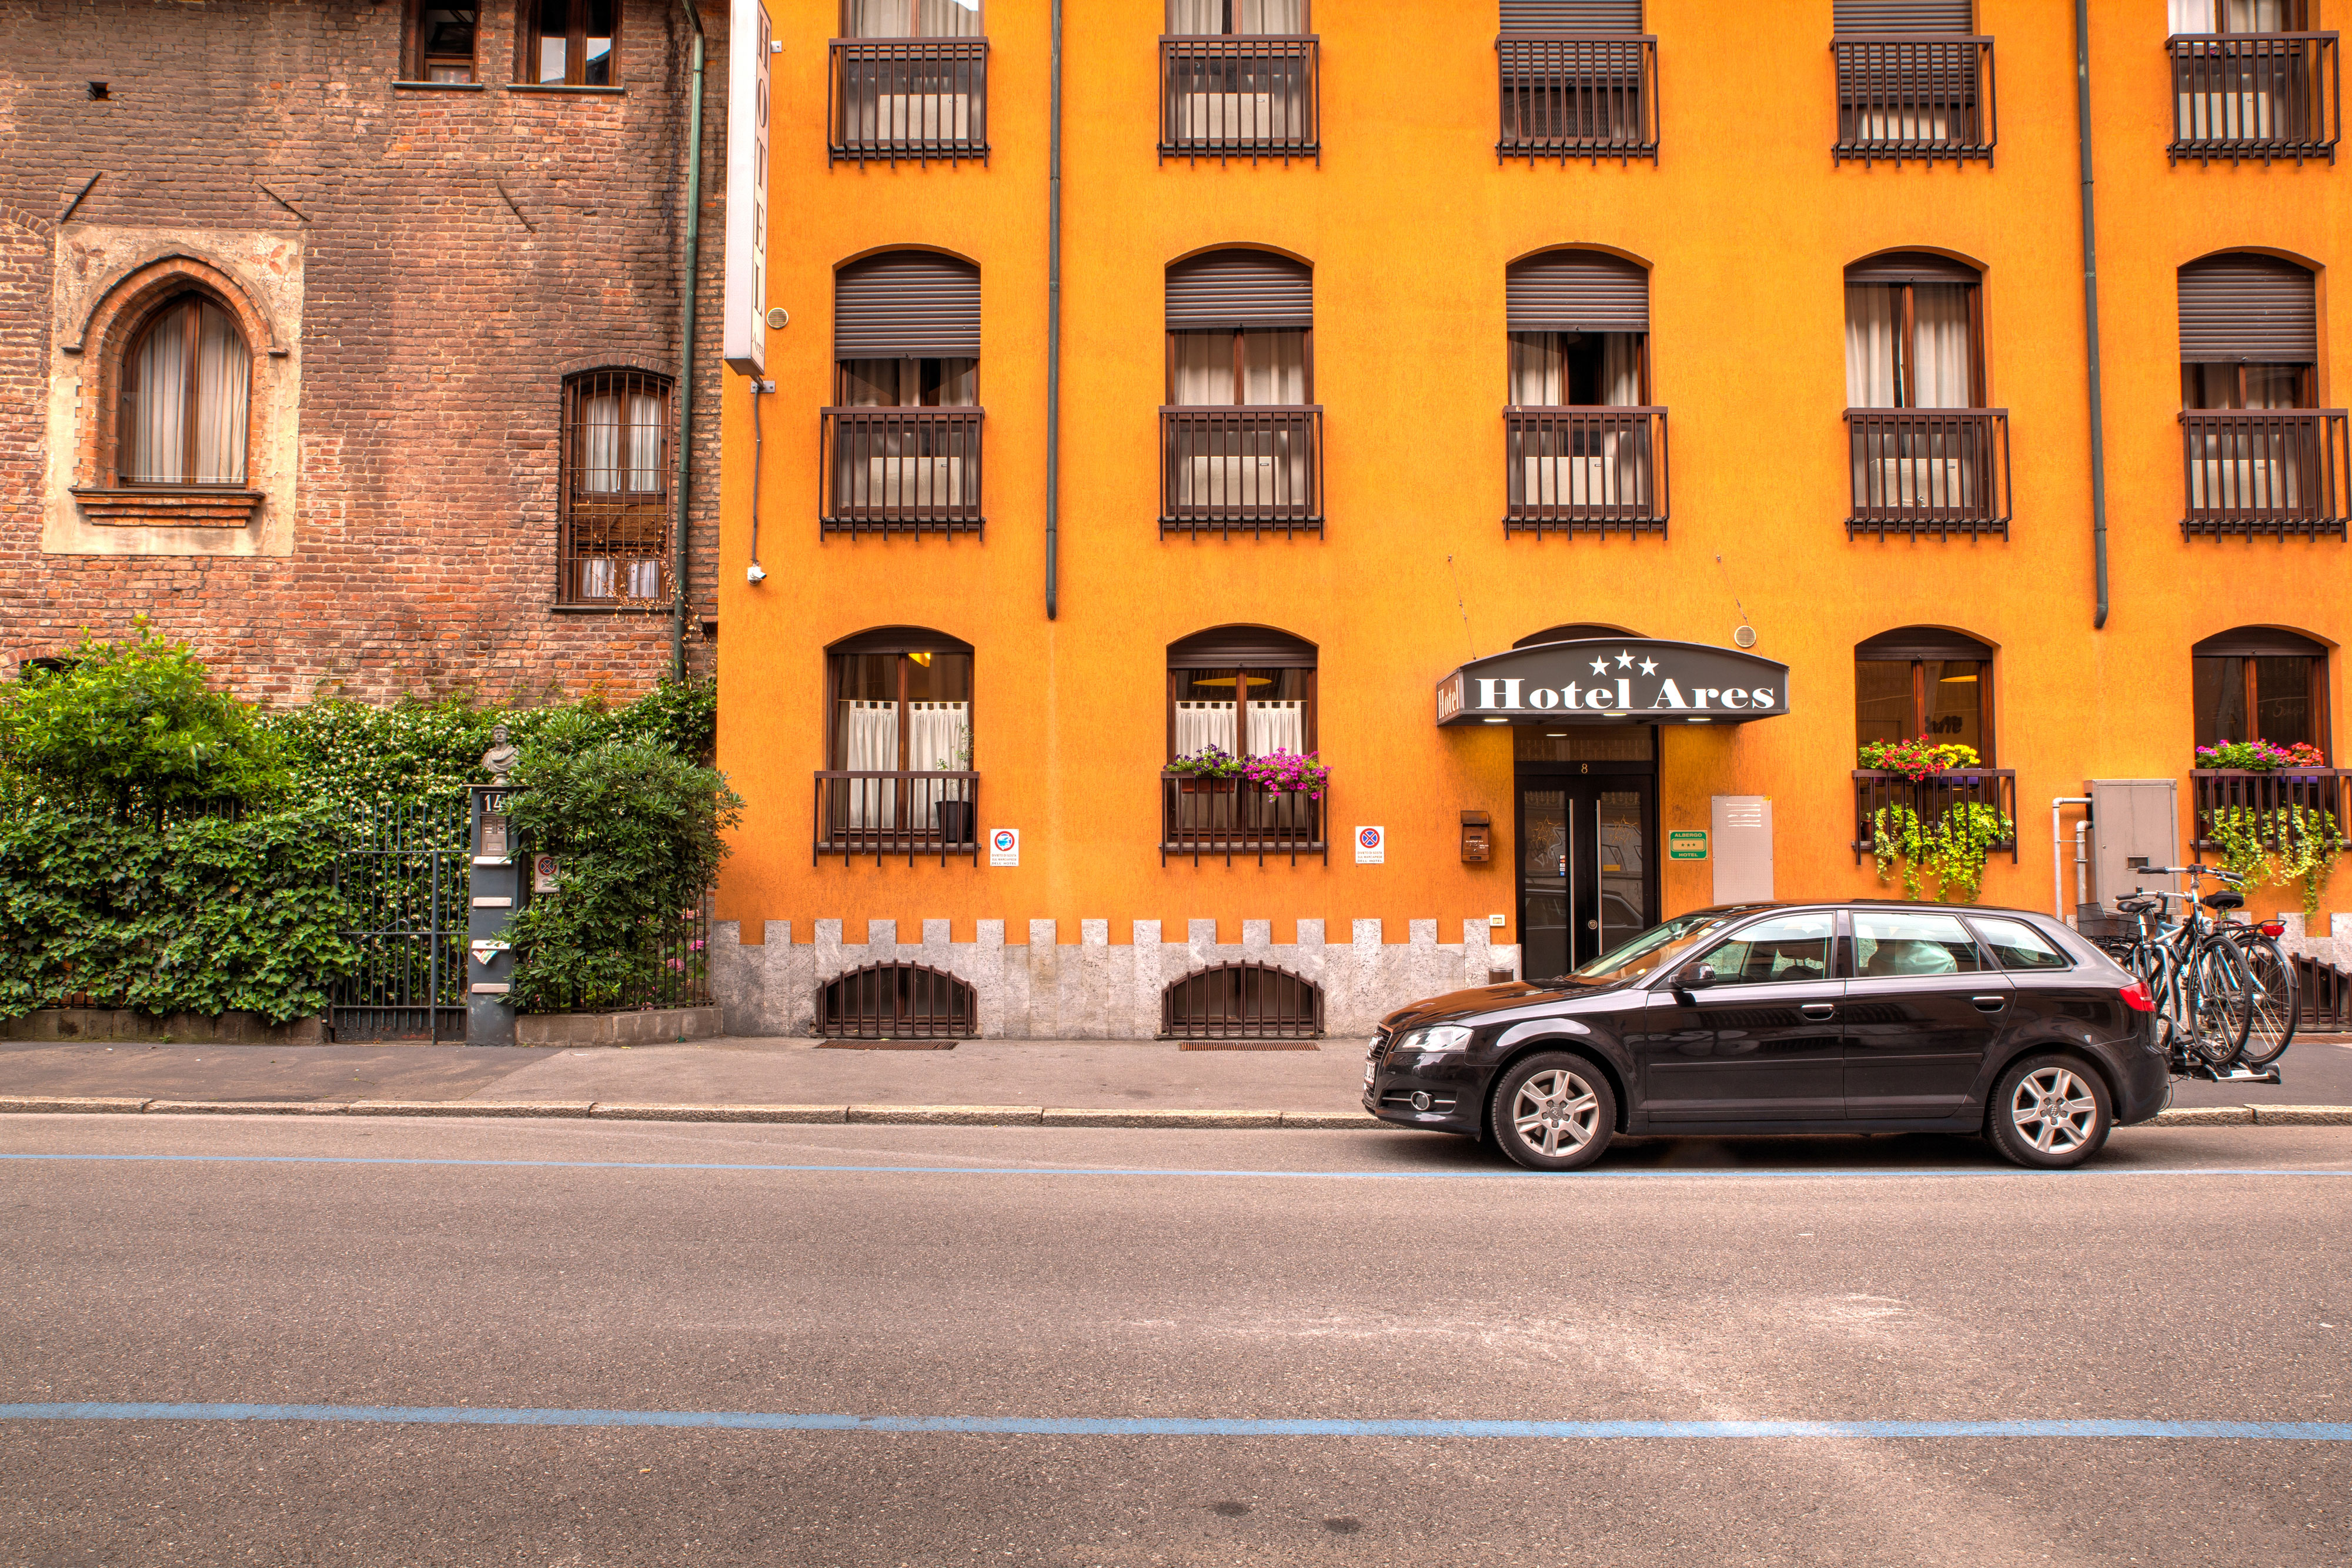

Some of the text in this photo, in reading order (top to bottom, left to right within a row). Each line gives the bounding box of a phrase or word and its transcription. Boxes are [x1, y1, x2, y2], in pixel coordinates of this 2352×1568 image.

[754, 10, 770, 317] HOTEL
[752, 332, 764, 357] Ares
[1438, 679, 1459, 720] Hotel
[1475, 678, 1775, 710] Hotel Ares
[1581, 763, 1588, 774] 8
[484, 794, 503, 811] 14
